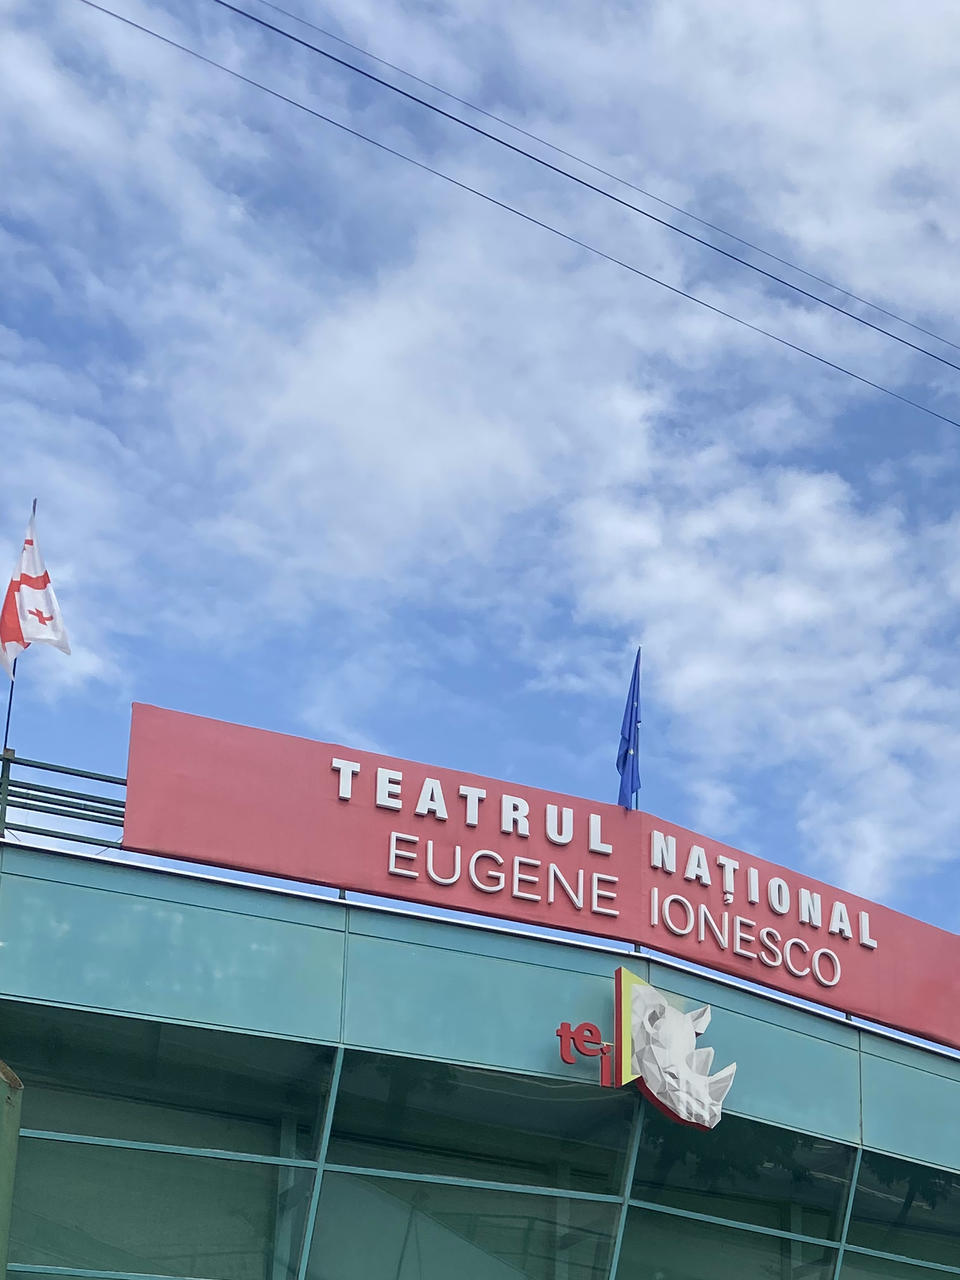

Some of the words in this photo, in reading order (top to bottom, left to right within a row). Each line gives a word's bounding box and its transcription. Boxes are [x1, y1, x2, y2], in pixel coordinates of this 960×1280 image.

[331, 757, 613, 856] TEATRUL
[650, 829, 878, 951] NAȚIONAL
[388, 831, 620, 917] EUGENE
[651, 886, 842, 988] IONESCO
